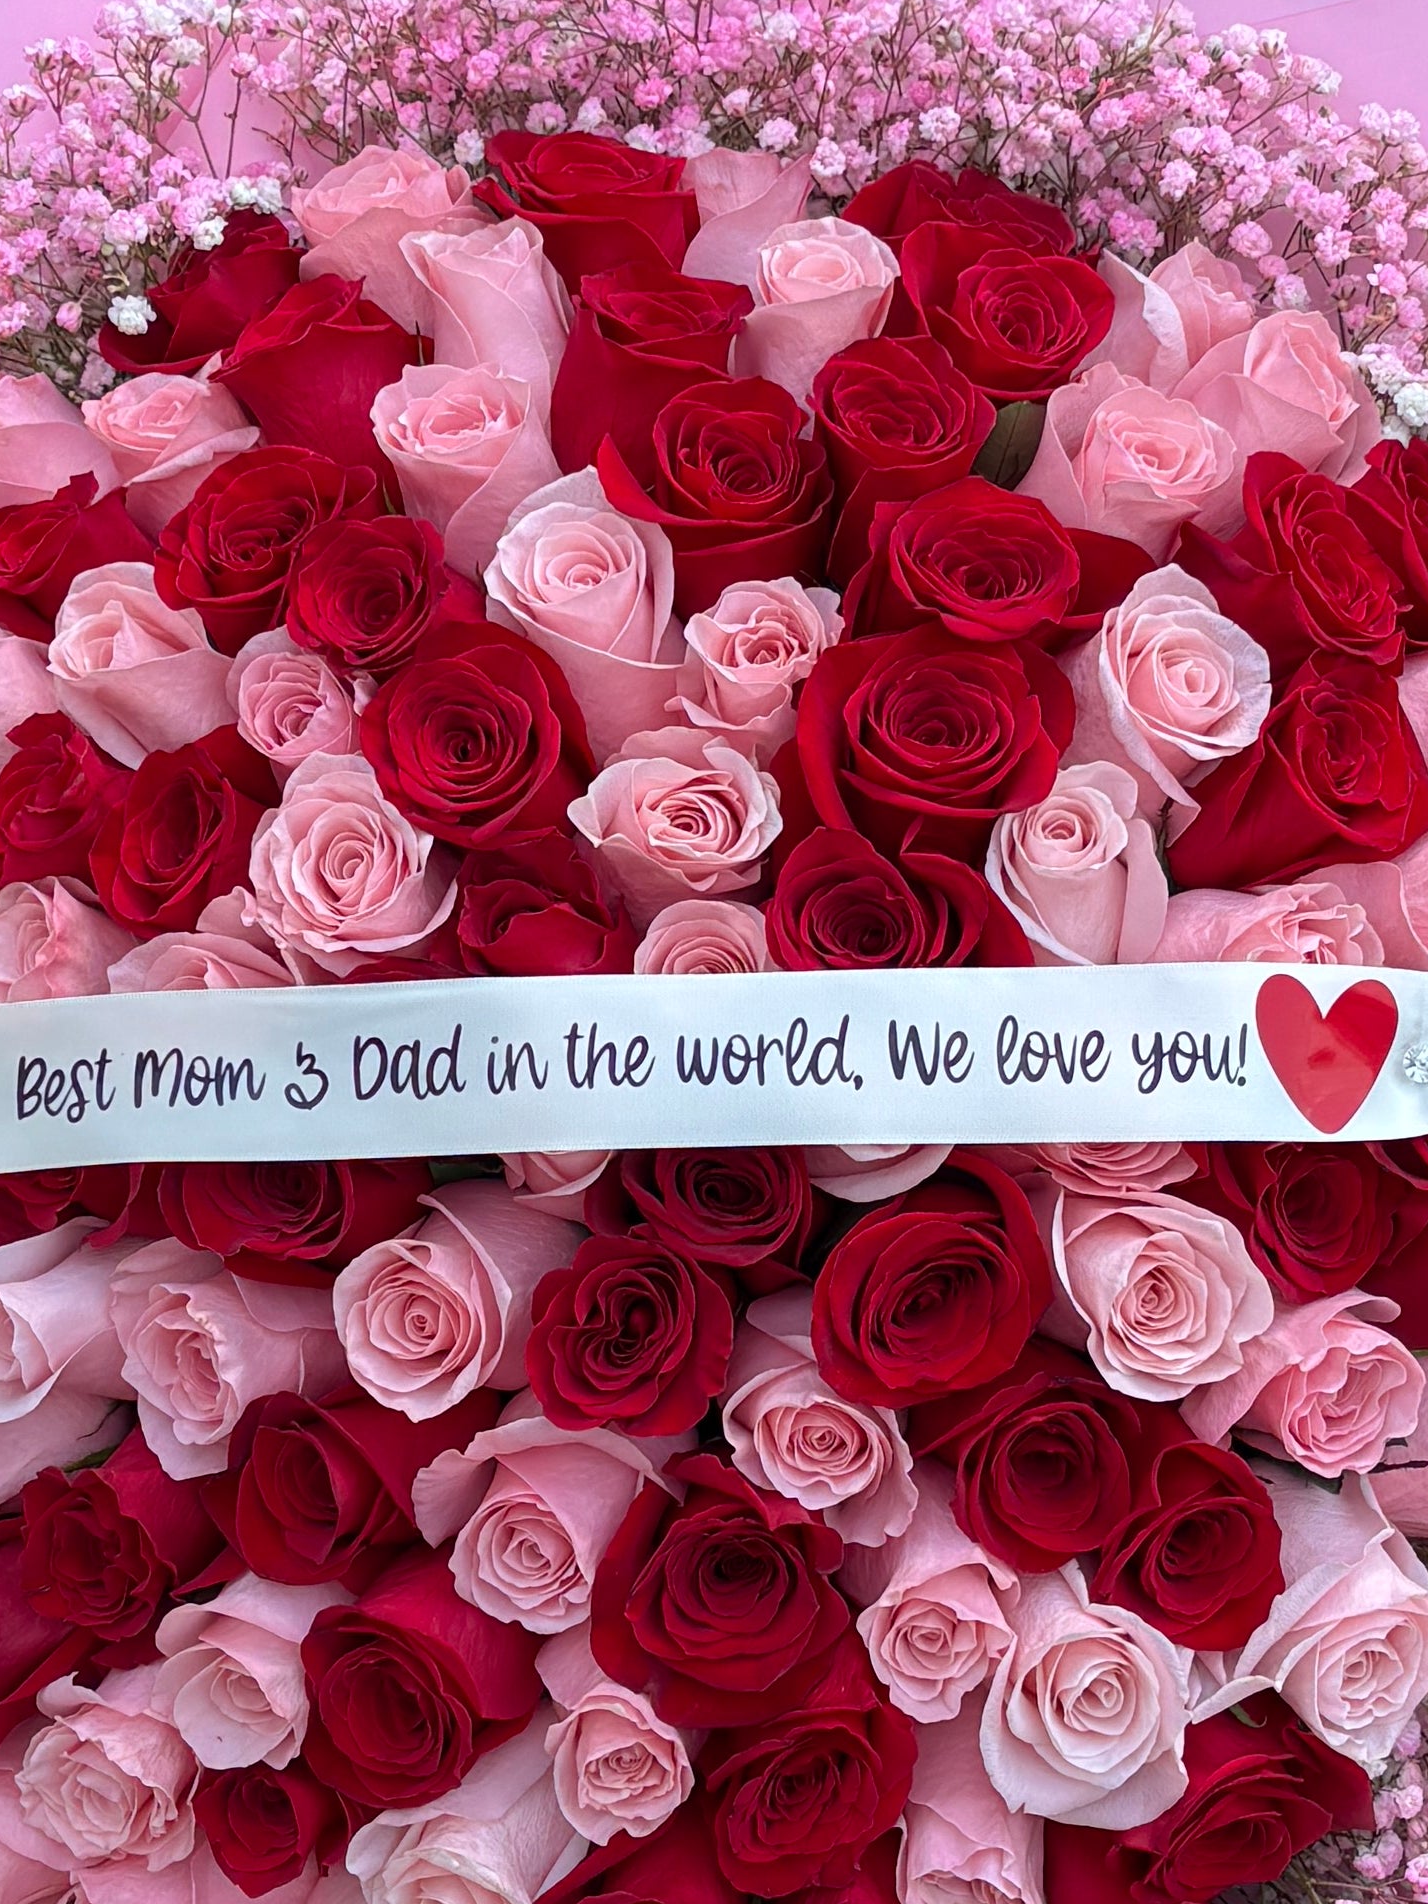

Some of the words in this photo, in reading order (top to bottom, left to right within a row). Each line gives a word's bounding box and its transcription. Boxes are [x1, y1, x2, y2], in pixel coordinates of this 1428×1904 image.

[17, 1047, 117, 1124] Best
[134, 1047, 267, 1109] Mom
[353, 1023, 467, 1101] Dad
[487, 1035, 549, 1095] in
[563, 1022, 656, 1090] the
[676, 1014, 864, 1093] world,
[888, 1019, 975, 1086] We
[996, 1014, 1112, 1085] love
[1131, 1022, 1249, 1095] you!
